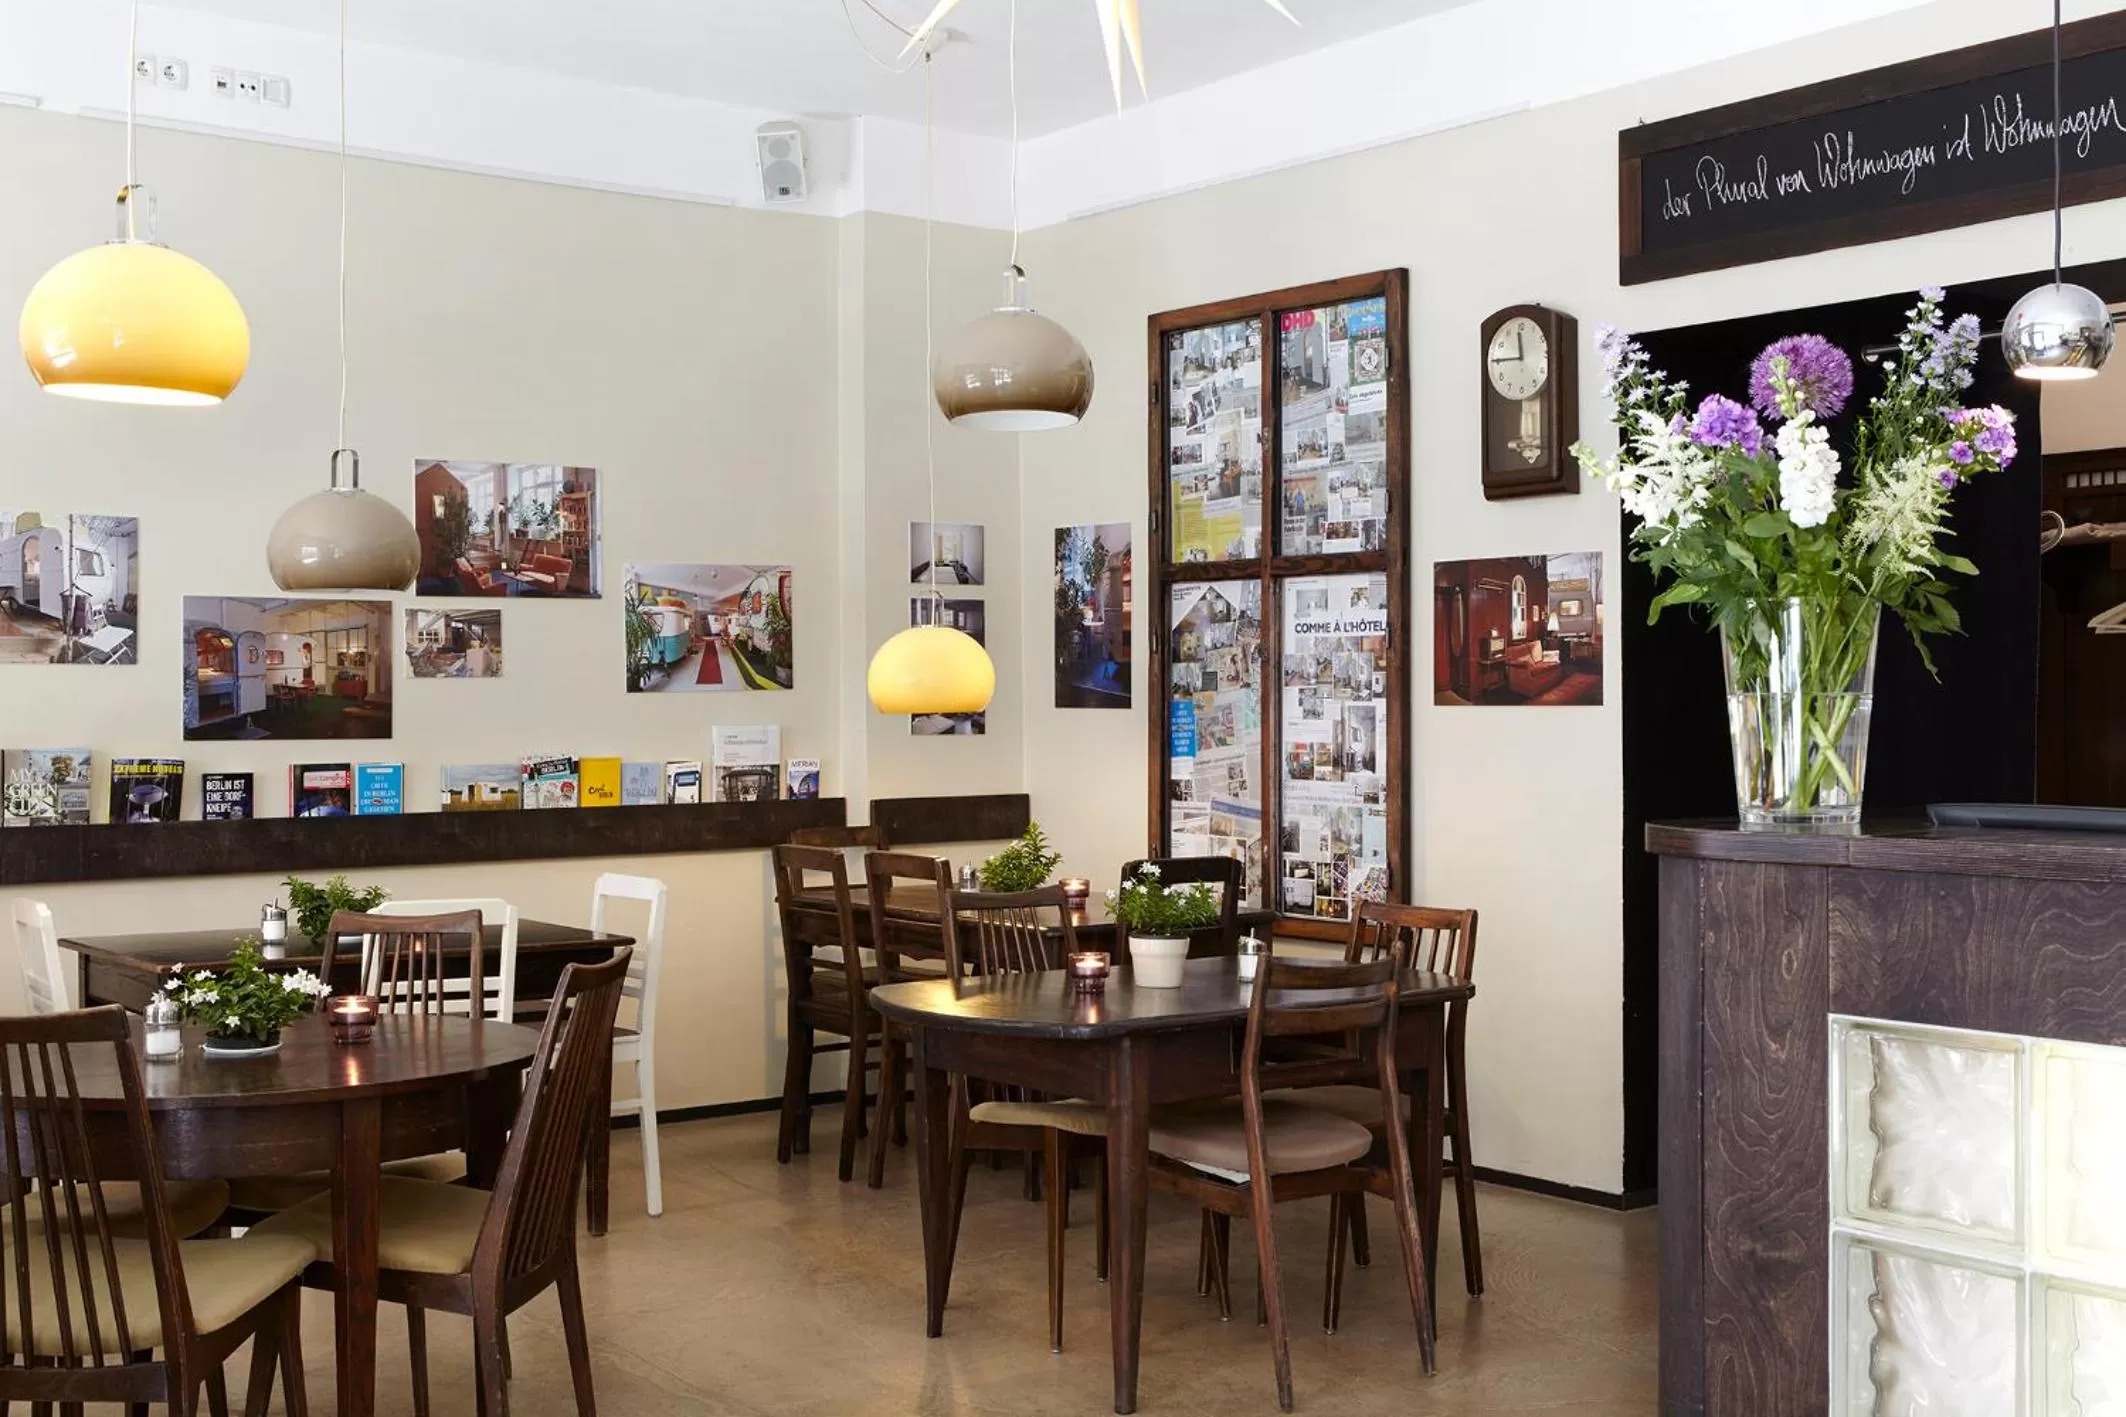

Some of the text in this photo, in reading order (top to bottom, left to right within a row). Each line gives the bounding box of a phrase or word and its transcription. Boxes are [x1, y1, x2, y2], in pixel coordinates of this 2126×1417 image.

[1663, 92, 2126, 220] der Plural von Wohnwagen ist Wohnwagen
[1294, 621, 1331, 634] COMME
[1333, 619, 1341, 633] À
[113, 764, 151, 774] EXTREME
[206, 779, 245, 791] BERLIN IST
[206, 790, 246, 802] EINE DORF-
[206, 802, 232, 813] KNEIPE
